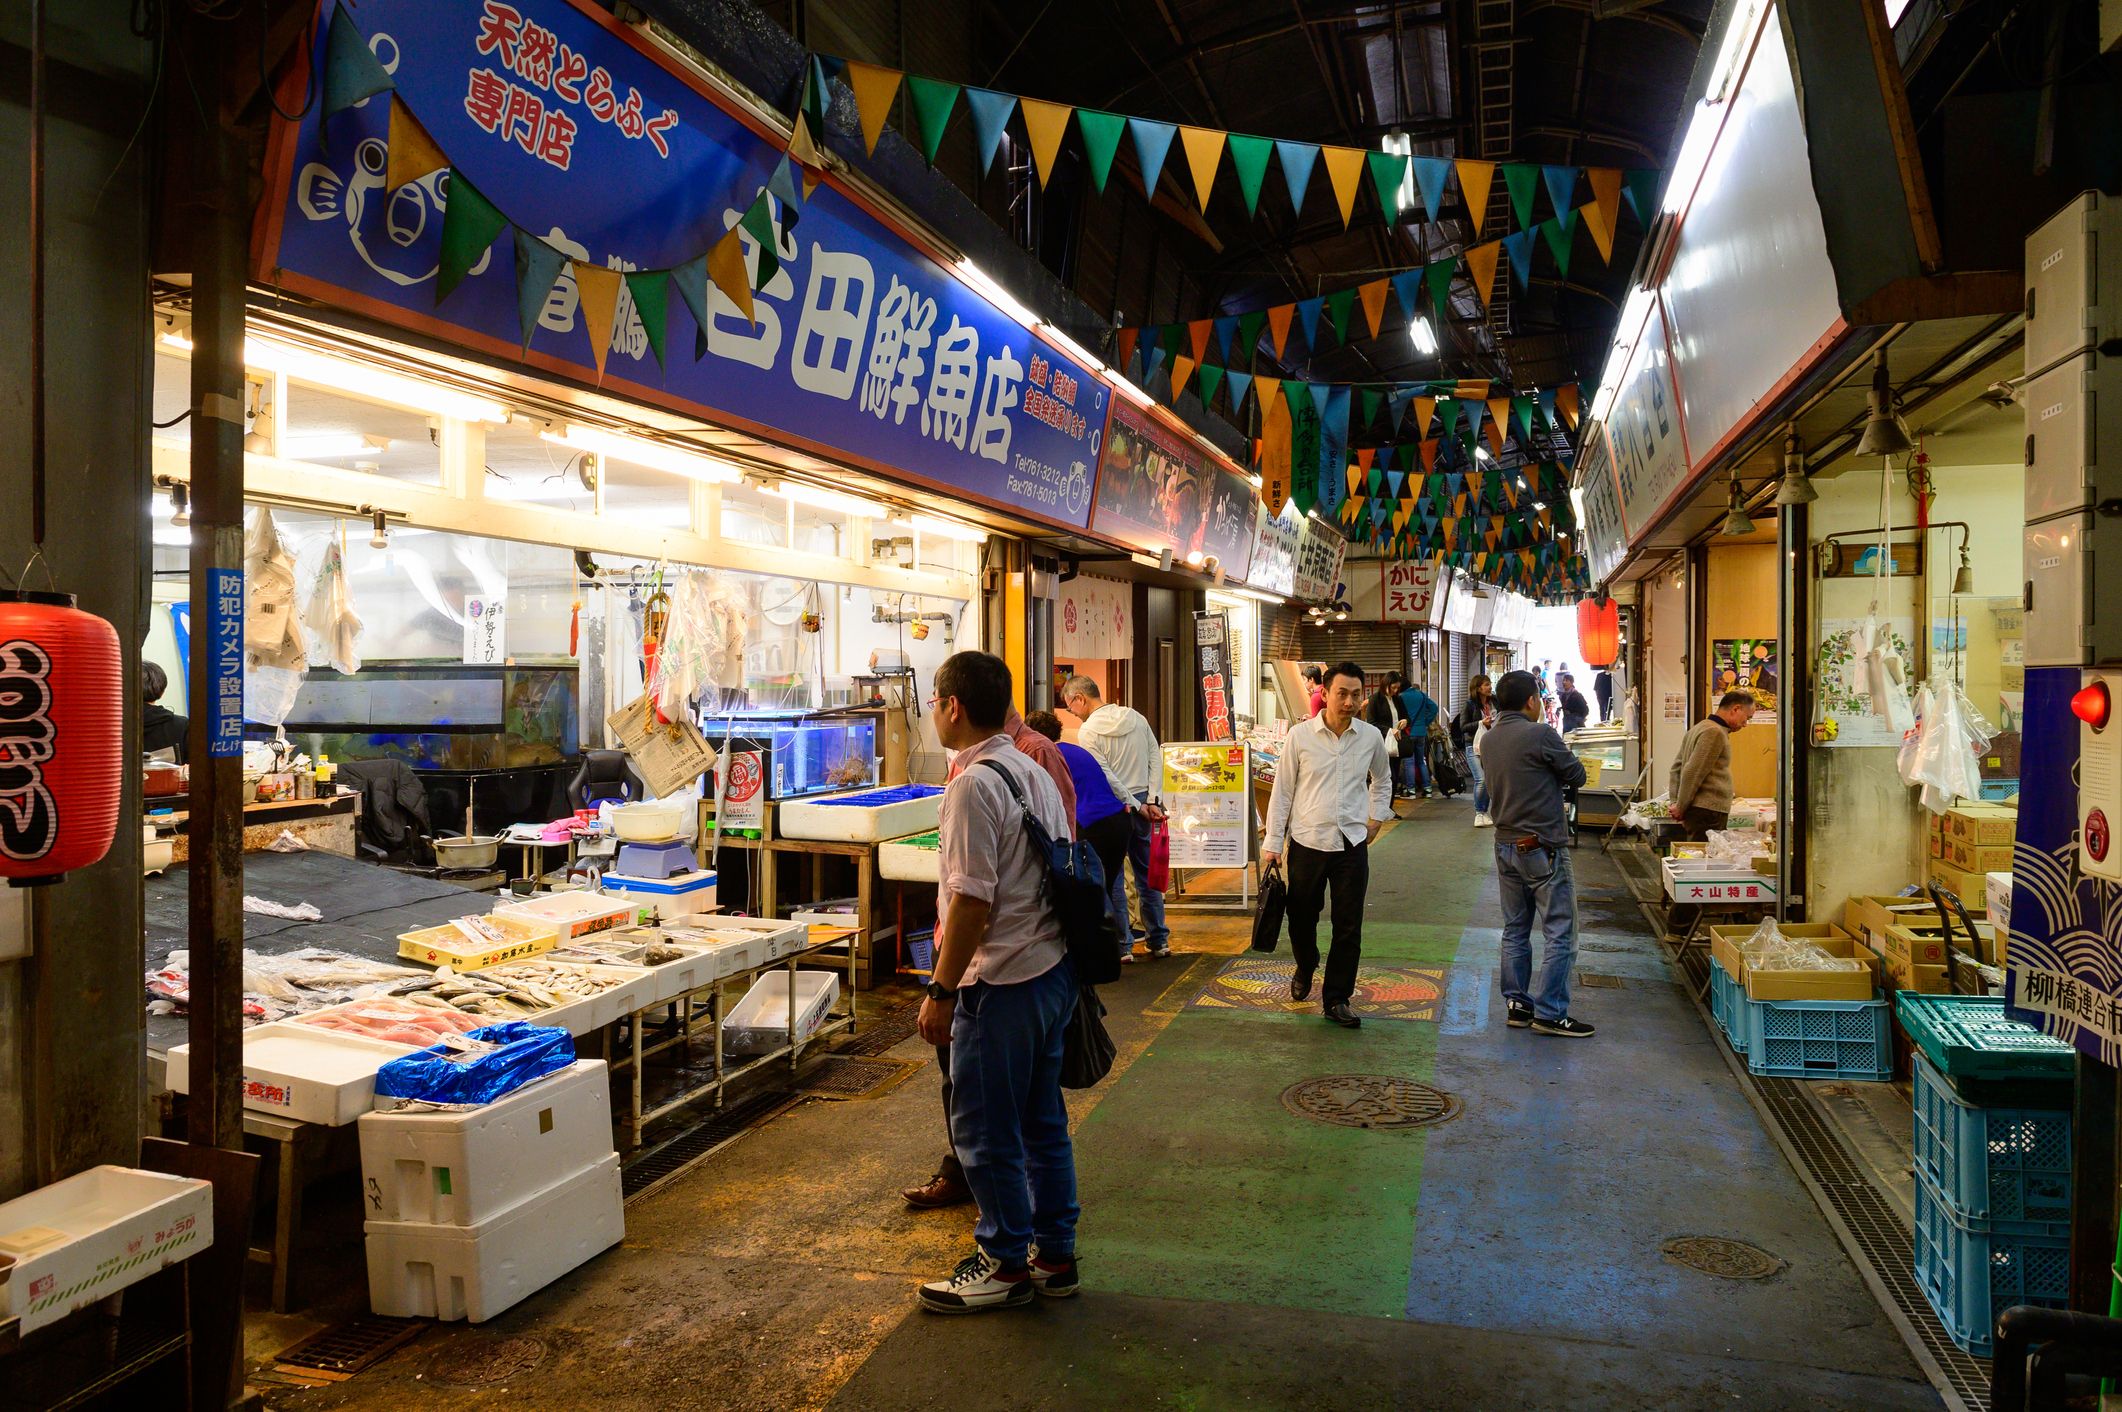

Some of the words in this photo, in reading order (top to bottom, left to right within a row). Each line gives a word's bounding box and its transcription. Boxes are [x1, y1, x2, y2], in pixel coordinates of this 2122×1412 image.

[476, 0, 679, 159] 天然とらふぐ
[465, 67, 578, 171] 専門店
[705, 186, 1024, 465] 吉田鮮魚店
[1272, 480, 1281, 508] 新鮮さ
[1390, 565, 1431, 586] かに
[1389, 591, 1431, 612] えび
[218, 575, 242, 737] 防犯カメラ設置店
[485, 607, 496, 662] 伊勢えび
[1739, 643, 1751, 688] 地球一周の
[733, 767, 745, 783] 福
[1691, 886, 1759, 898] 大山特産
[2024, 969, 2122, 1036] 柳橋連合市
[154, 1215, 196, 1244] みょうが
